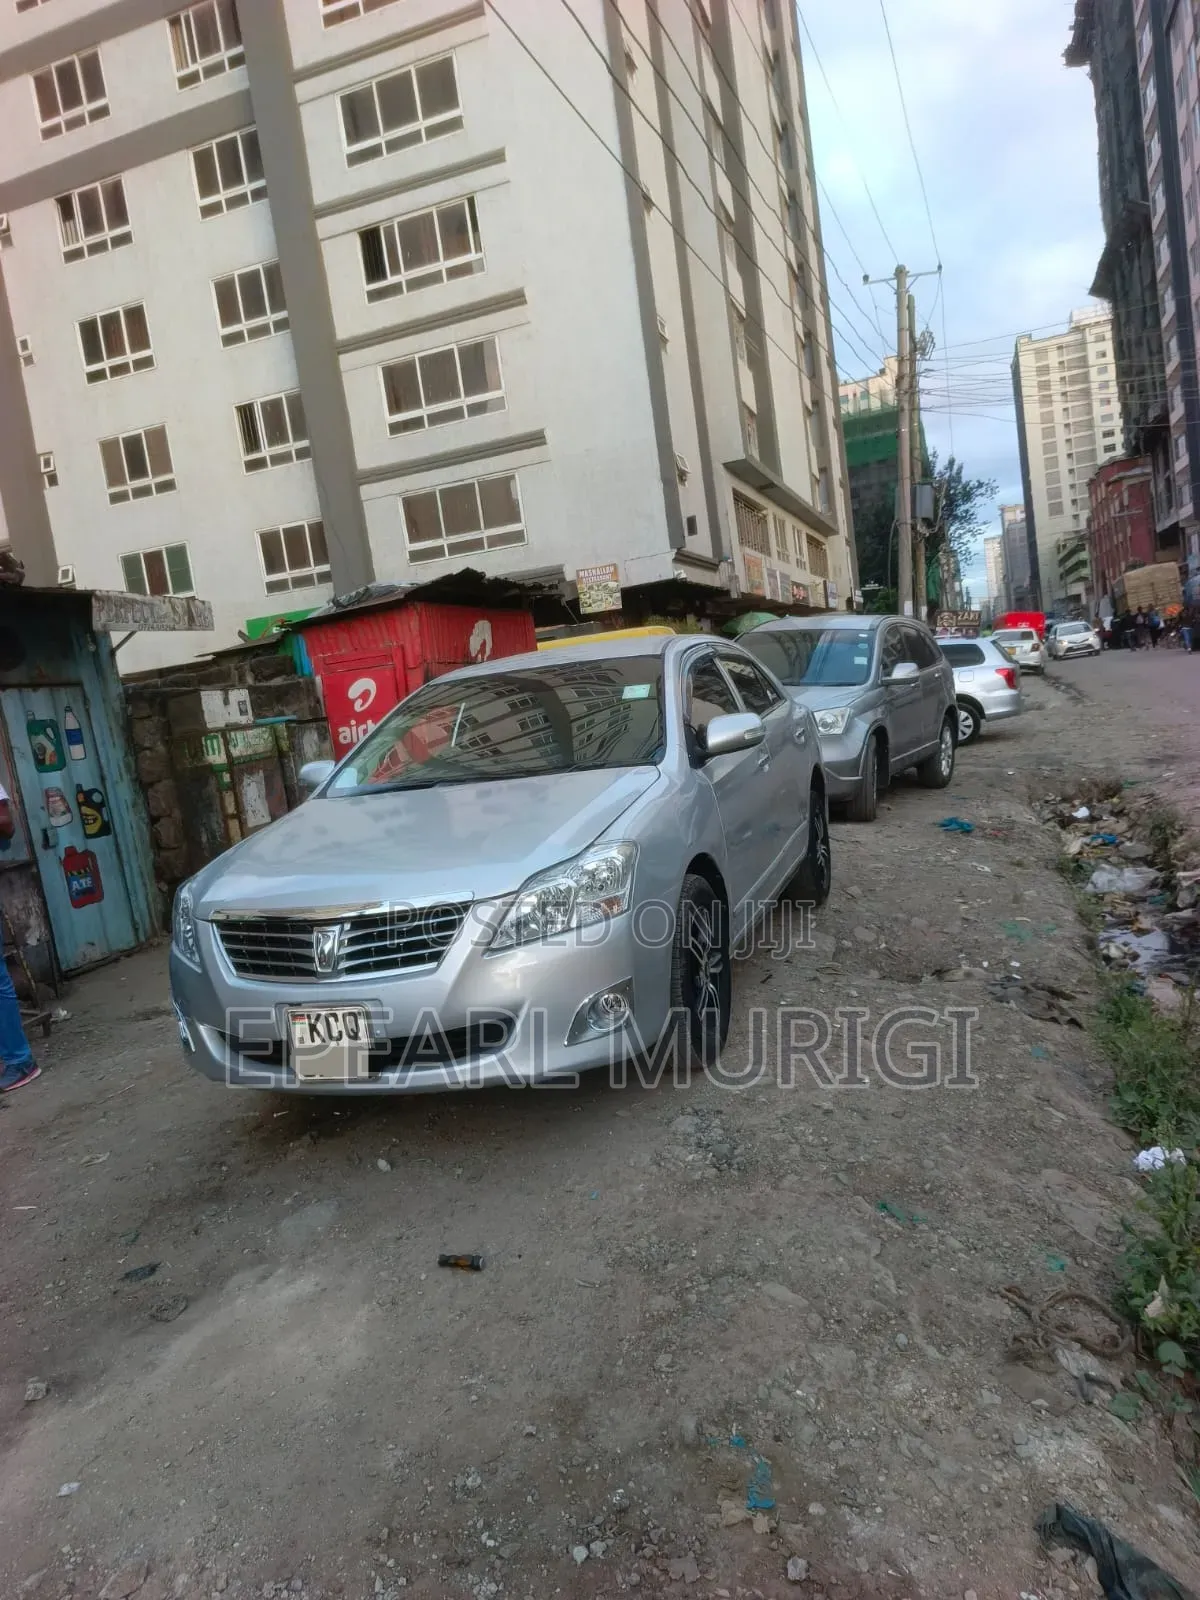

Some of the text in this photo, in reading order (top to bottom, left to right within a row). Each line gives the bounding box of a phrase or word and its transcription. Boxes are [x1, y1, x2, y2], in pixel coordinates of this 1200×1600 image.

[579, 565, 614, 578] MASHALLAH
[957, 611, 979, 621] ZAKI
[306, 1011, 361, 1043] KCQ
